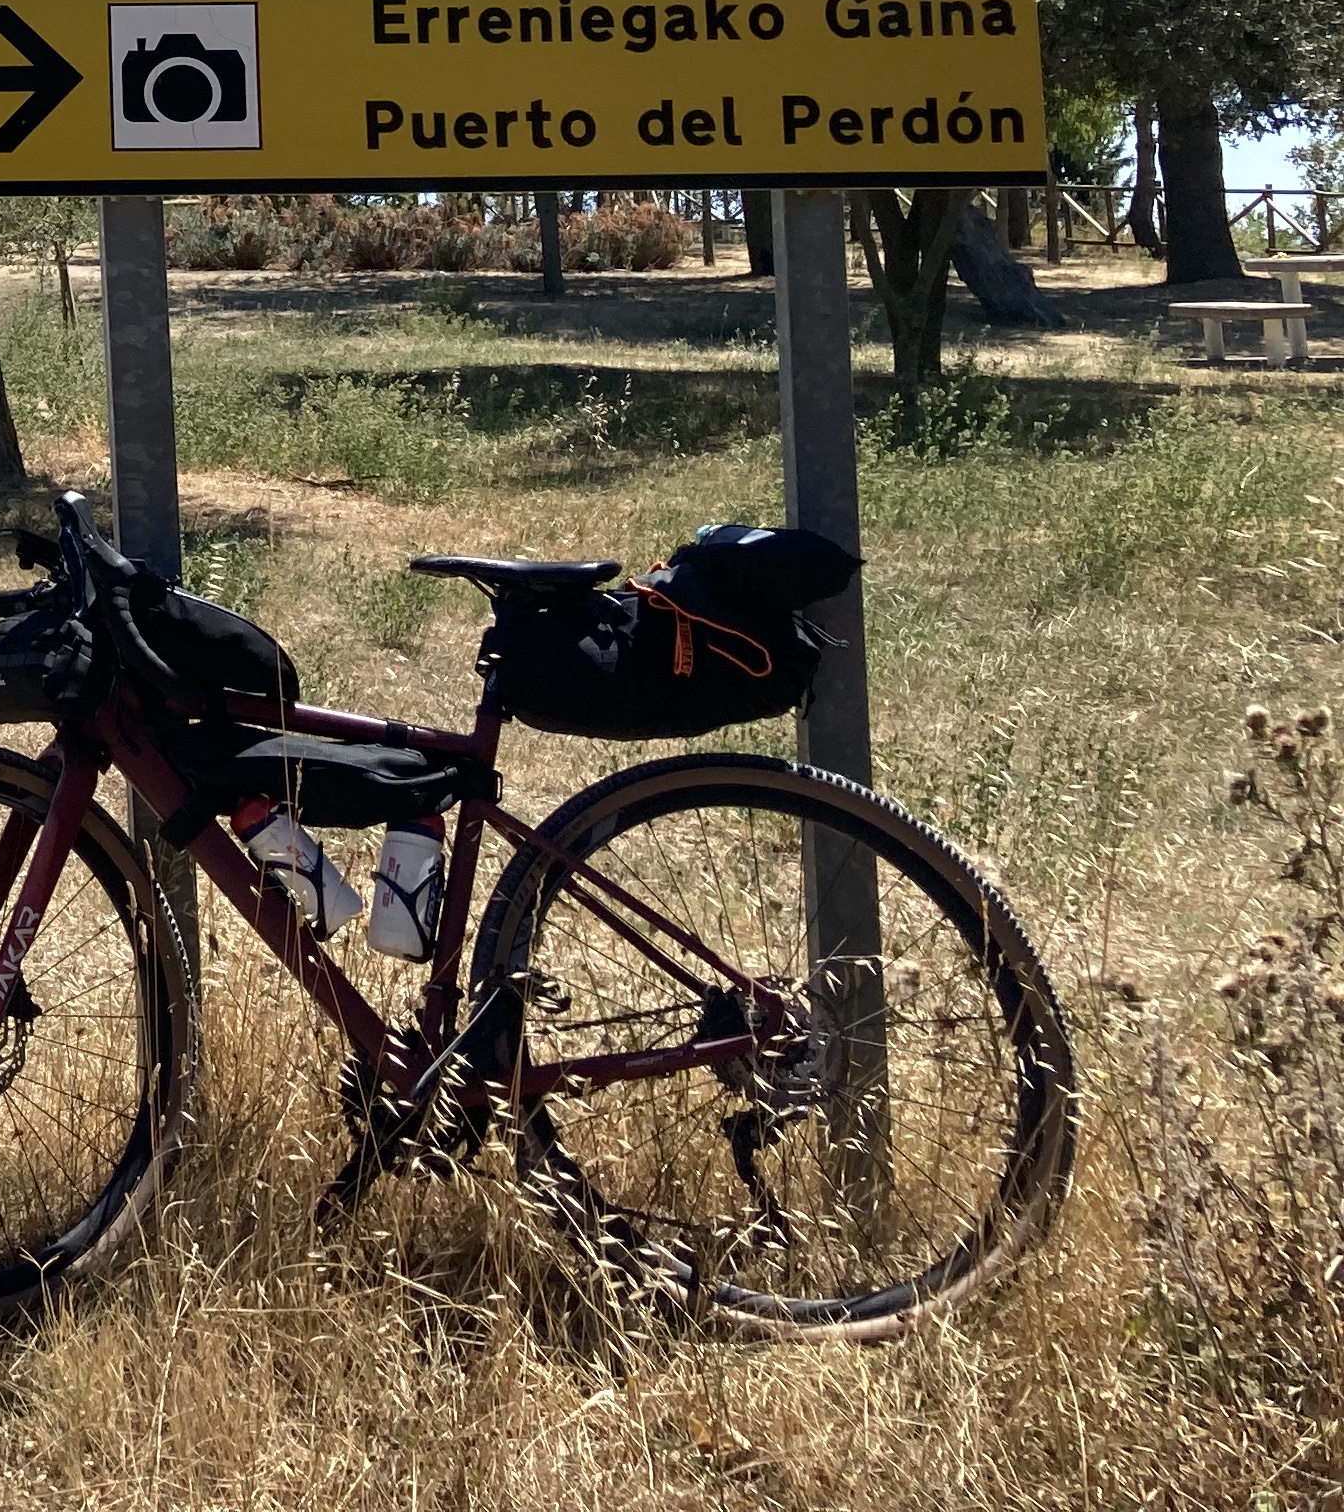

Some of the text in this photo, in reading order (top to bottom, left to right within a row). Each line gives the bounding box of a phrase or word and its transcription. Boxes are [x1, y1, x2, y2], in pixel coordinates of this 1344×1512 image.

[365, 90, 1026, 151] Puerto del Perdón
